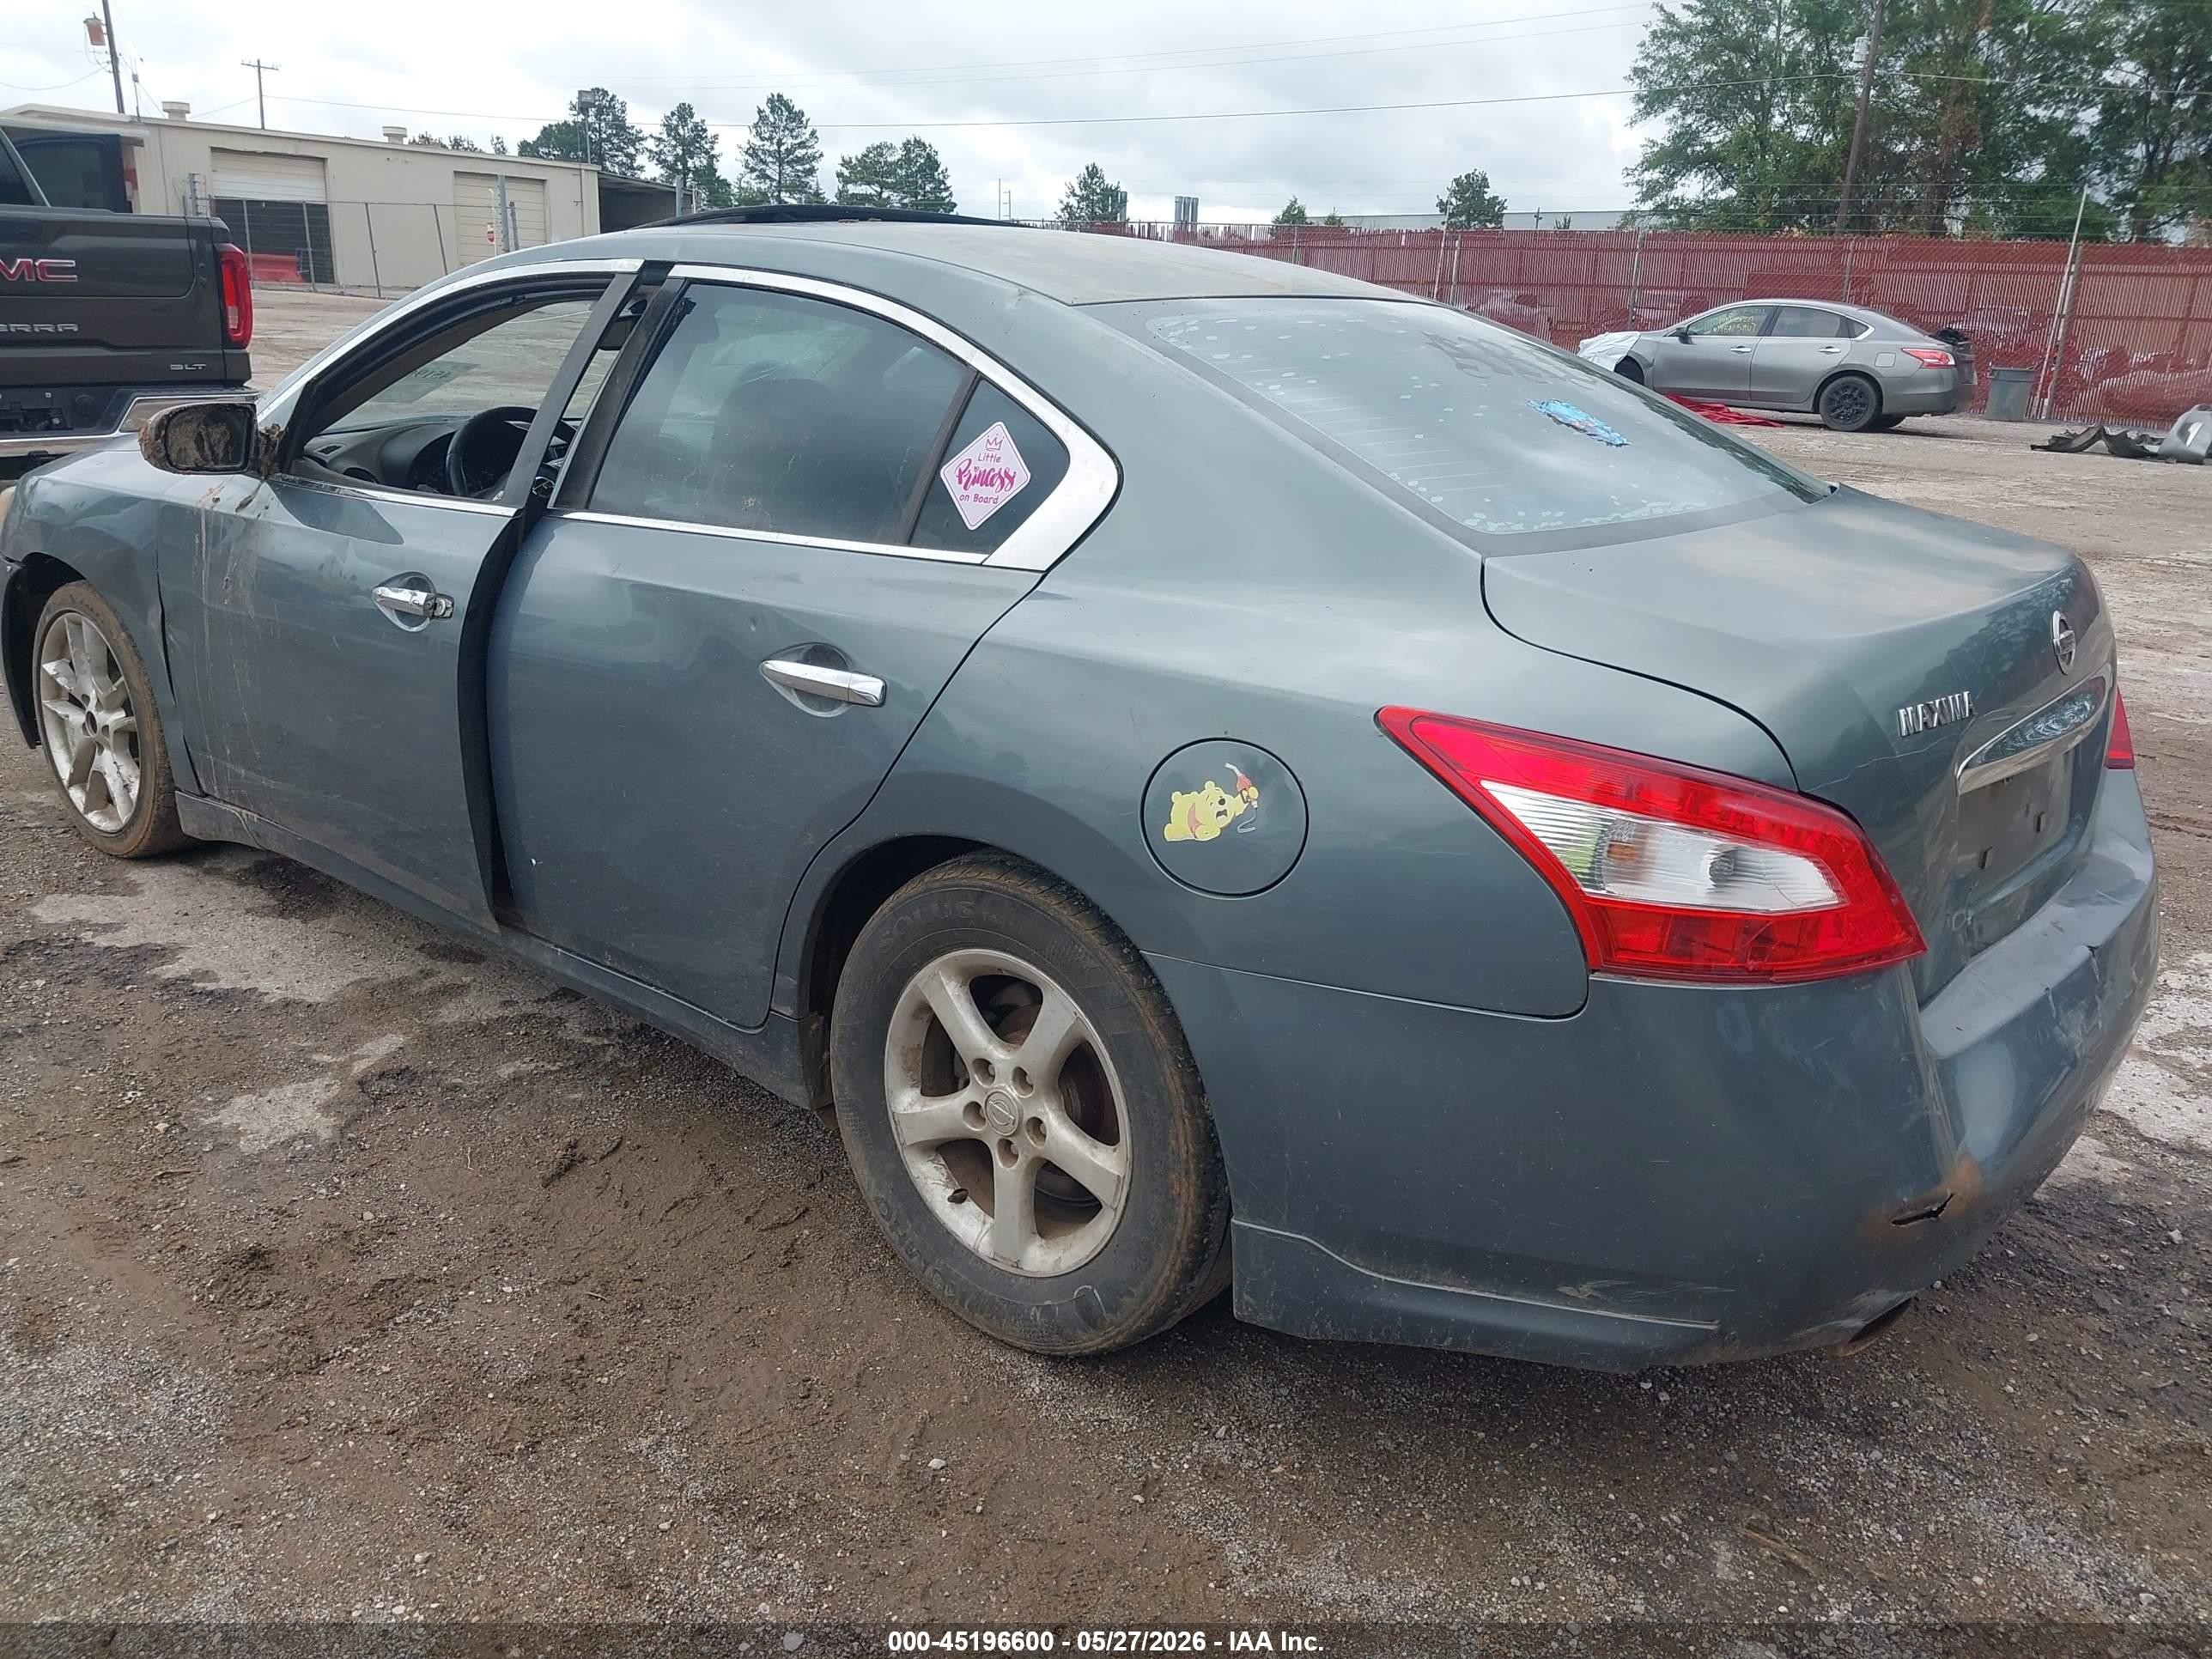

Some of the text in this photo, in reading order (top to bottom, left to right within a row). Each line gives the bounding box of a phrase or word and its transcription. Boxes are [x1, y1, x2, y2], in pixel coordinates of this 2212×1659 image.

[169, 362, 207, 371] SLT
[977, 452, 1001, 464] Little
[956, 459, 1016, 492] Princess
[959, 492, 1000, 505] on Board
[1898, 691, 1974, 737] MAXIMA
